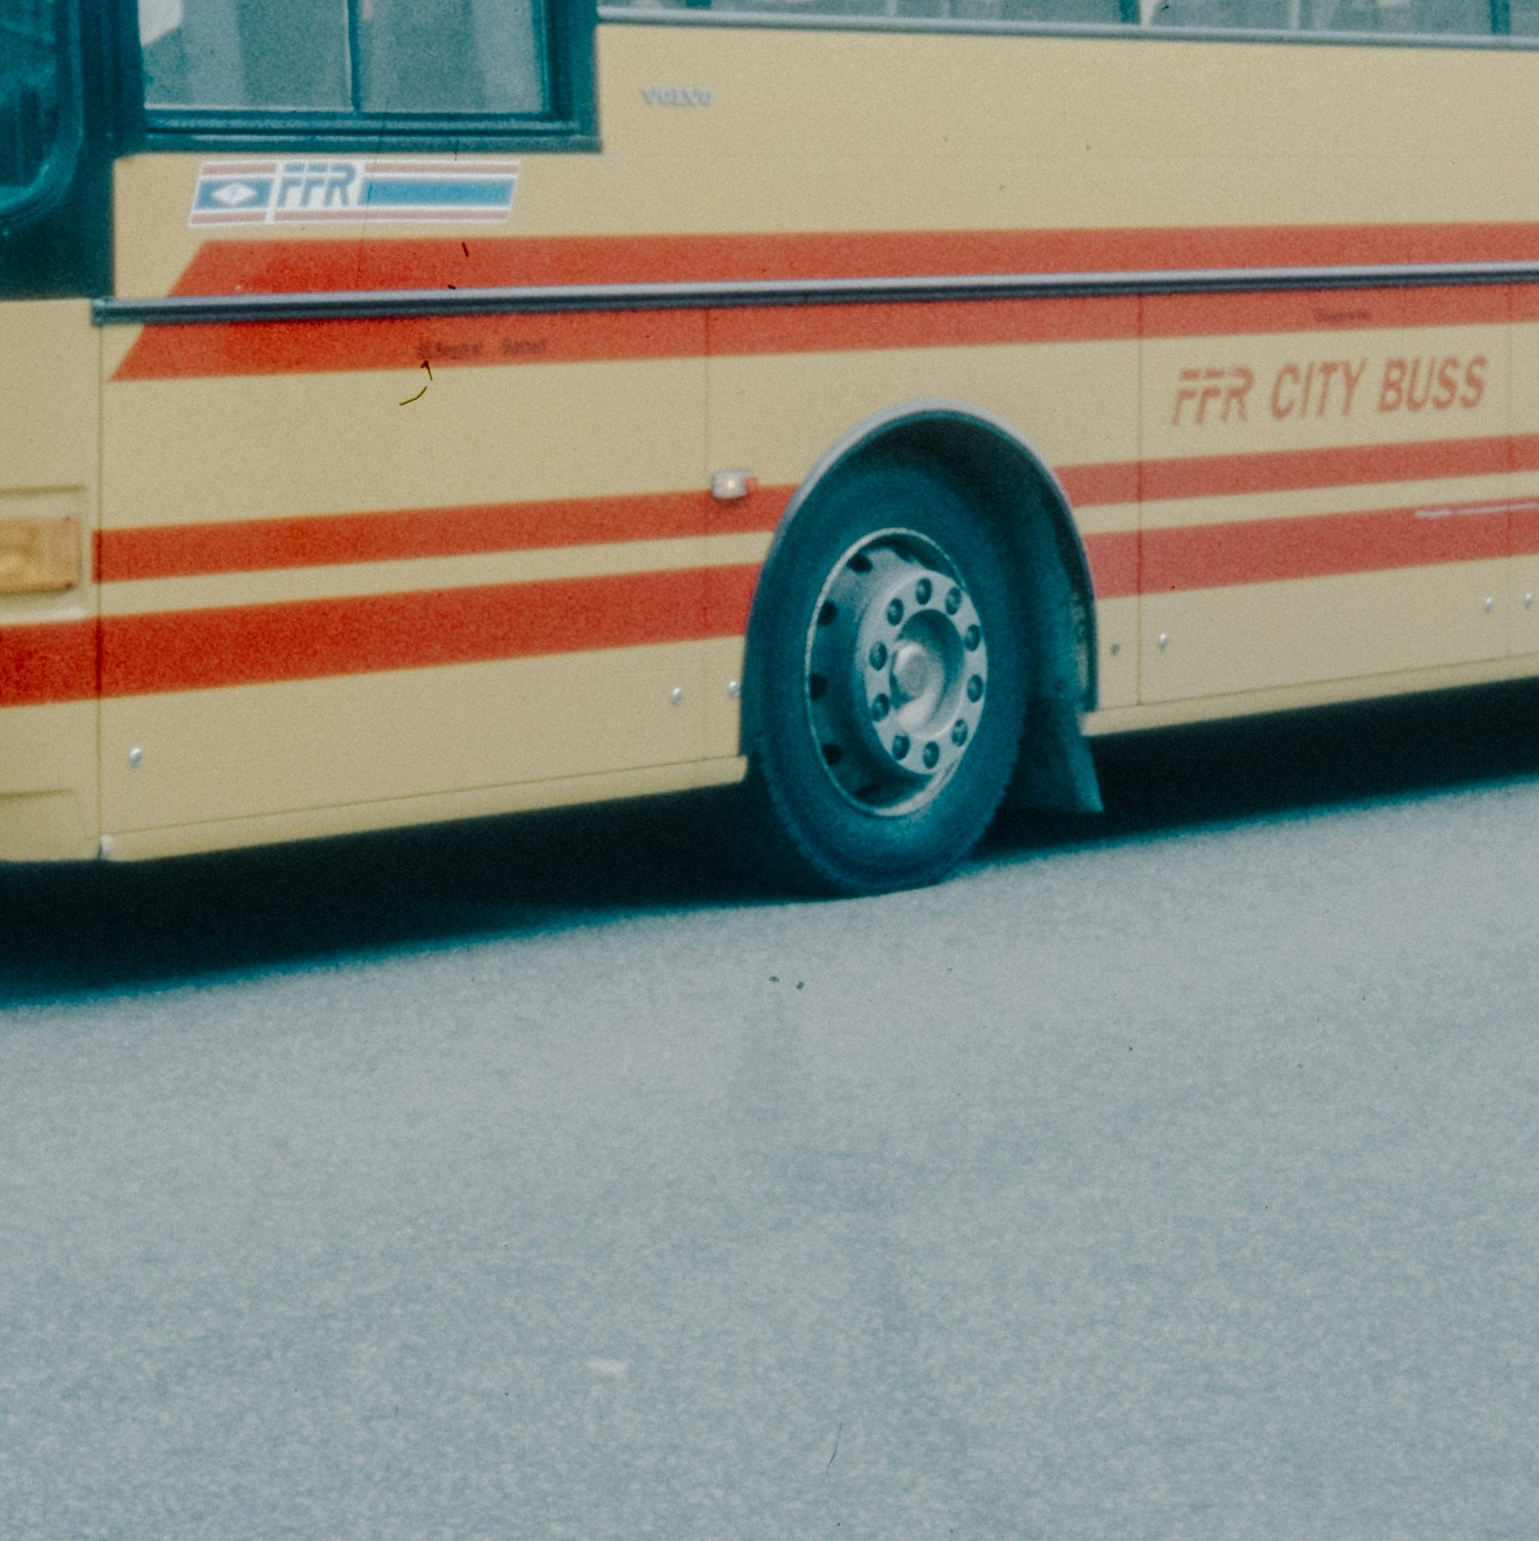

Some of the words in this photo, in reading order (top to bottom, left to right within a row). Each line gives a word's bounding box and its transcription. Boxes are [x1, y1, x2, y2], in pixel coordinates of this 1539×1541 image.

[639, 86, 716, 107] VOLVO
[277, 162, 357, 207] FFR
[1172, 365, 1255, 426] FFR
[1270, 361, 1364, 420] CITY
[1378, 355, 1487, 413] BUSS
